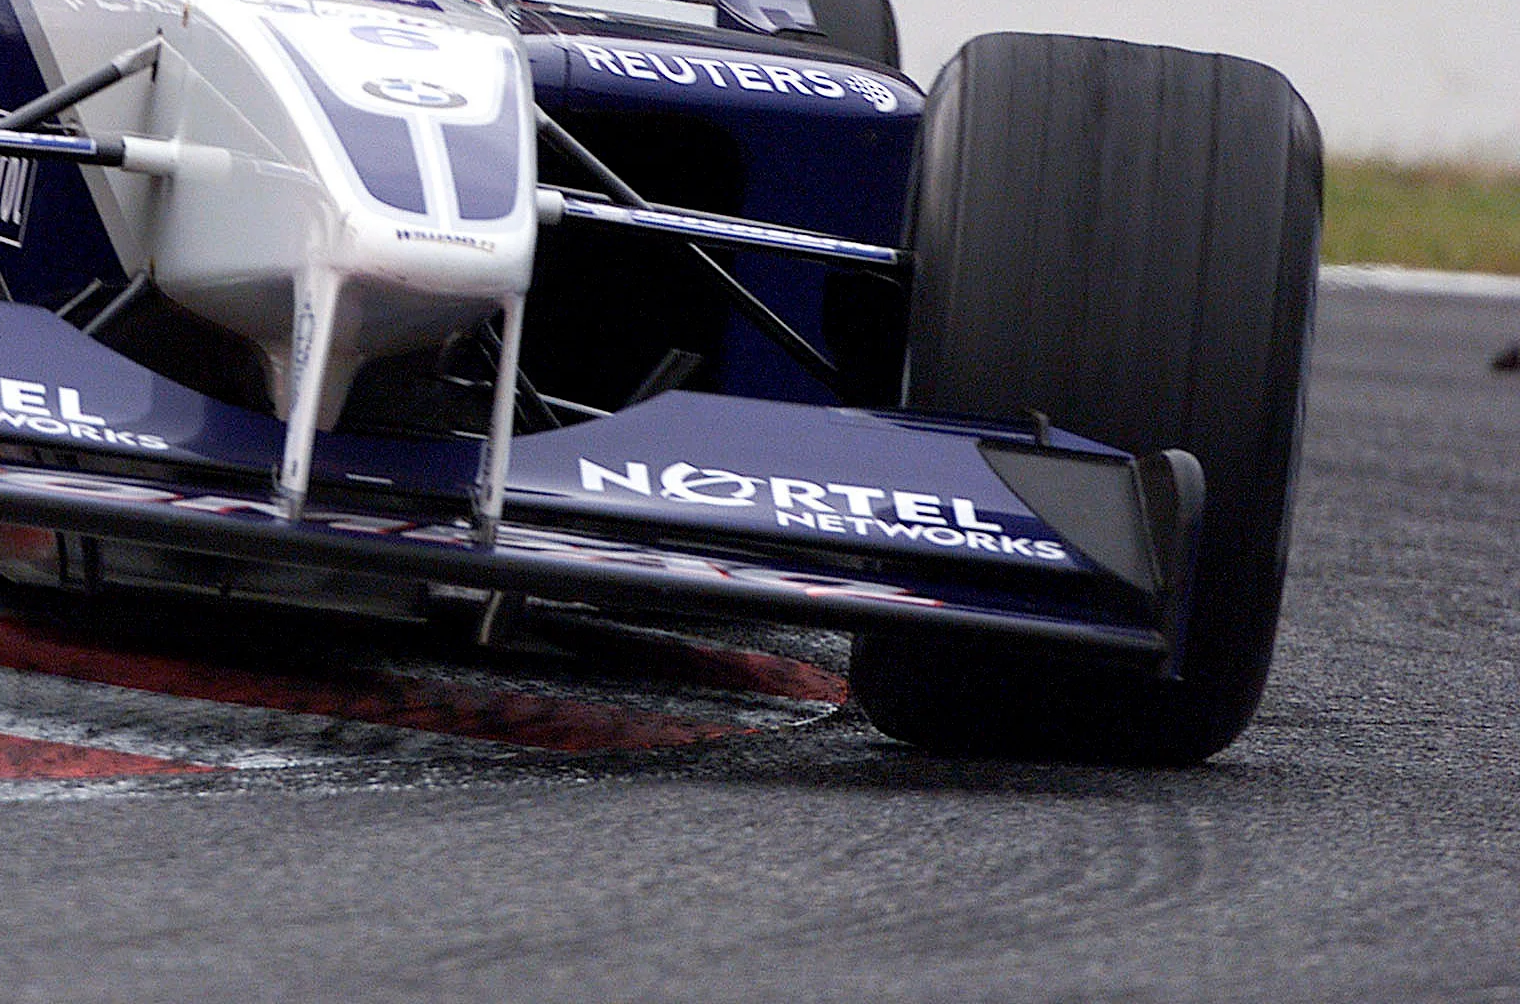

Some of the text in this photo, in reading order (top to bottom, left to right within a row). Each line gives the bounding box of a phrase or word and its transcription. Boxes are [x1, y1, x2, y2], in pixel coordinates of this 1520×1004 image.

[573, 42, 846, 99] REUTERS
[579, 456, 1004, 534] NORTEL
[776, 508, 1068, 561] NETWORKS
